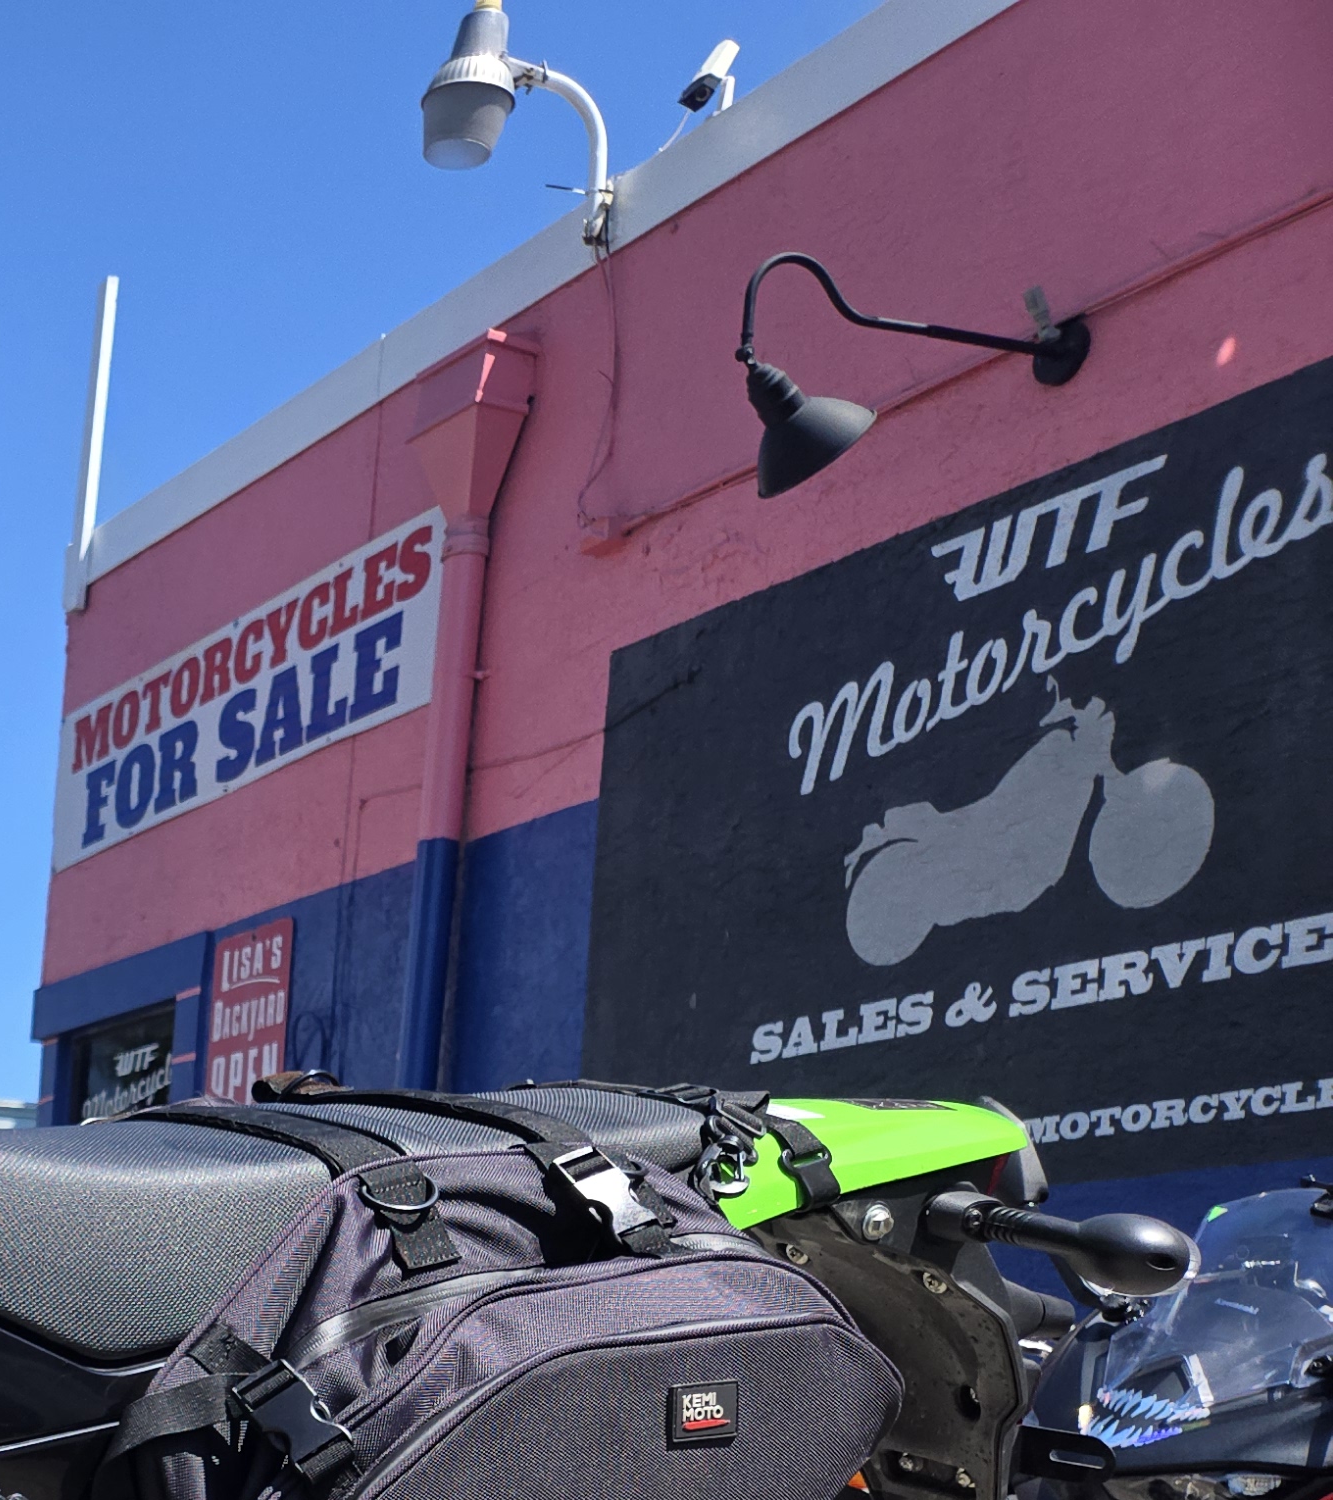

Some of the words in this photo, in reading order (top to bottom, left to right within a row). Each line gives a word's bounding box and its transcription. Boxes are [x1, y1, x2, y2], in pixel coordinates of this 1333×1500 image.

[932, 454, 1167, 601] WTF
[71, 525, 433, 774] MOTORCYCLES
[789, 453, 1333, 794] Motorcycles
[82, 721, 199, 849] FOR
[215, 610, 404, 783] SALE
[221, 935, 283, 992] LISA'S
[750, 989, 933, 1064] SALES
[945, 981, 996, 1026] &
[1008, 912, 1333, 1017] SERVICE
[114, 1043, 159, 1077] WTF
[211, 1042, 278, 1105] OPEN
[682, 1392, 717, 1409] KEMI
[683, 1405, 724, 1422] MOTO
